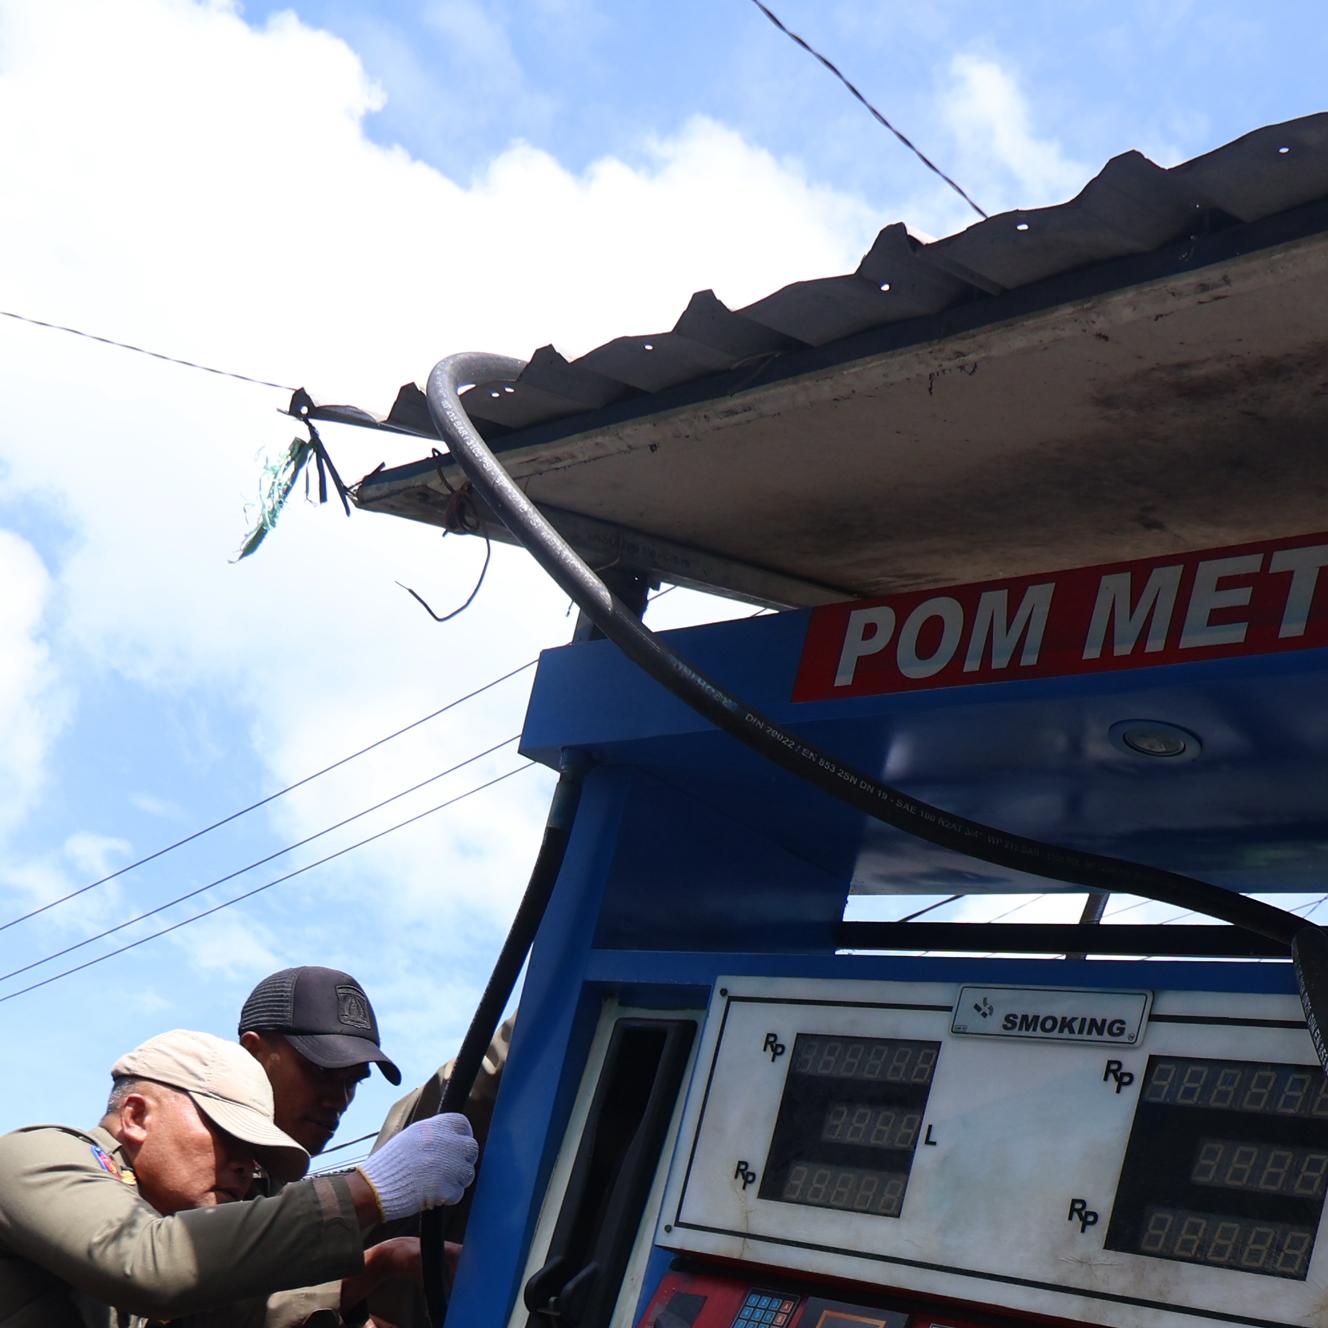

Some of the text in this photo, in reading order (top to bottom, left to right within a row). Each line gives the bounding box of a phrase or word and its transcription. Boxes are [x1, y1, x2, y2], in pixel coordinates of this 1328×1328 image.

[834, 581, 1054, 687] POM
[1001, 1013, 1126, 1038] SMOKING
[924, 1123, 938, 1146] L
